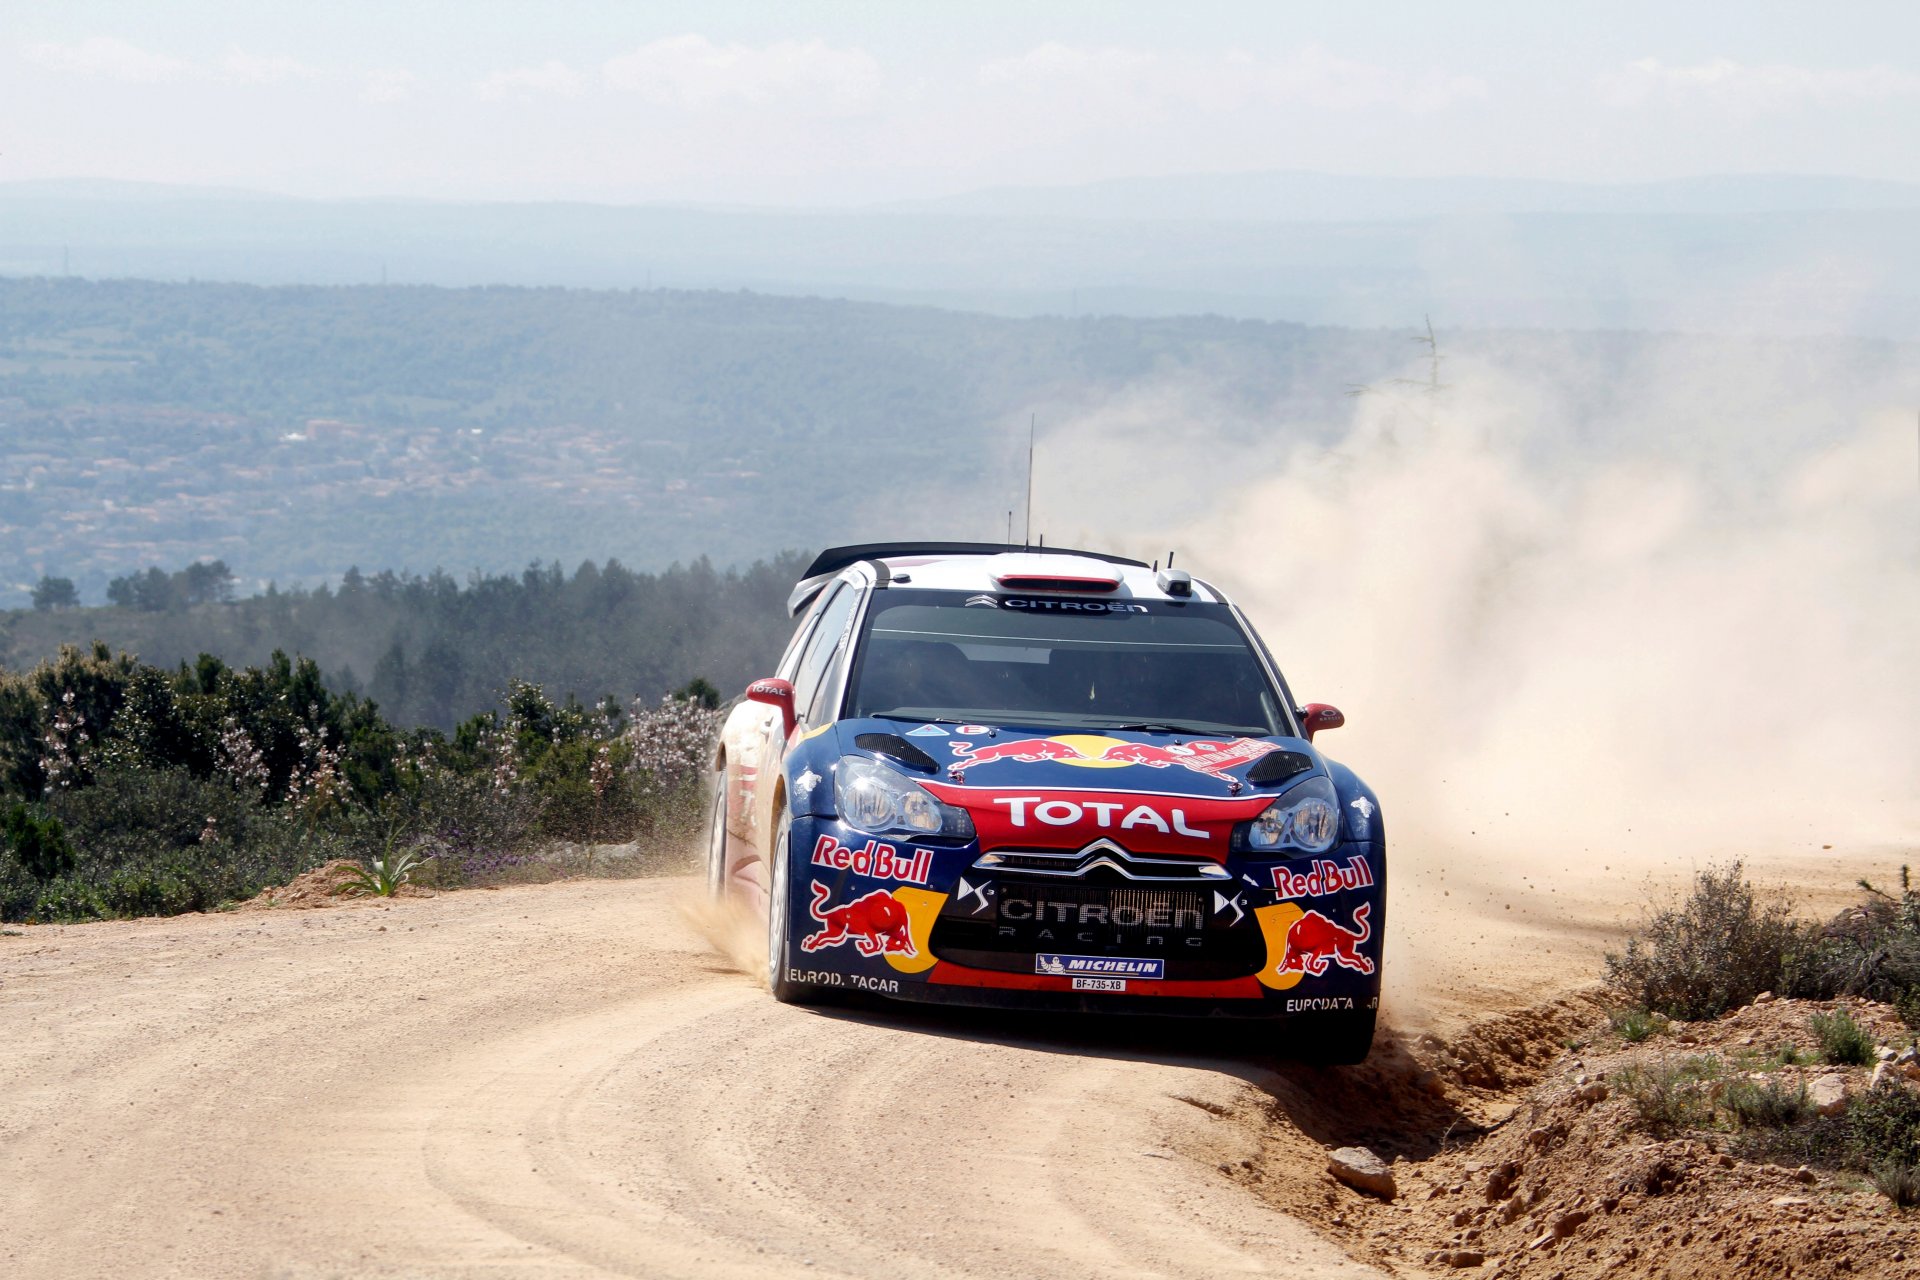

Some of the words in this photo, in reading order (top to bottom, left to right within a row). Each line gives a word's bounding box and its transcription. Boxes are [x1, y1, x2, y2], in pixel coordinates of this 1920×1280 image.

[752, 684, 786, 696] TOTAL
[993, 796, 1210, 839] TOTAL
[998, 926, 1203, 947] RACING
[1068, 958, 1158, 974] MICHELIN
[1075, 979, 1122, 991] BF-735-XB
